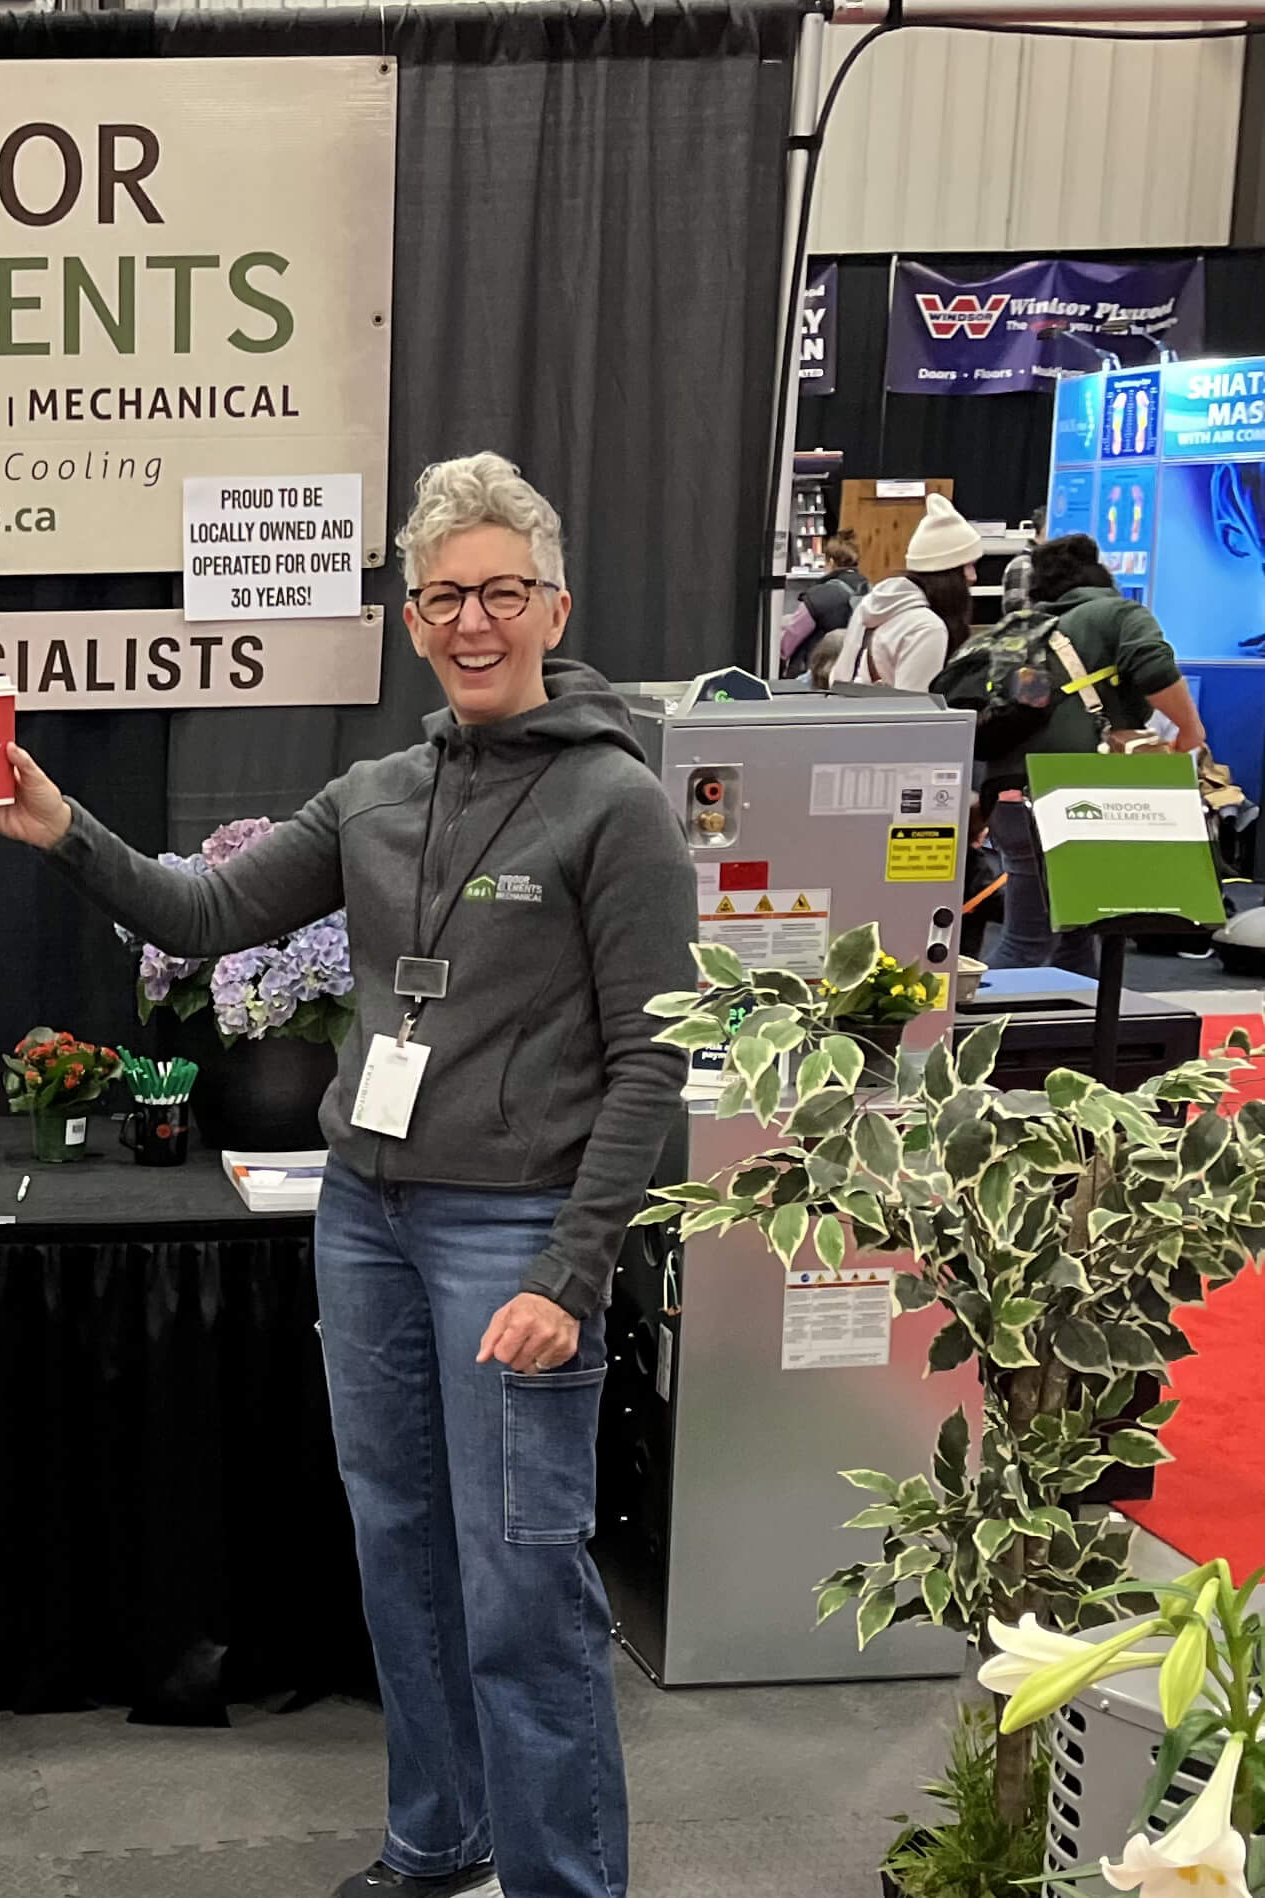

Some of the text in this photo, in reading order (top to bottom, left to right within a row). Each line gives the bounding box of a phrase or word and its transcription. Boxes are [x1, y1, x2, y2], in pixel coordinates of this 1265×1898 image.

[929, 312, 993, 322] WINDSOR
[1009, 298, 1091, 316] Windsor
[918, 368, 1013, 380] Doors Floors
[28, 385, 300, 422] MECHANICAL
[1178, 431, 1211, 446] WITH
[1212, 429, 1235, 443] AIR
[4, 451, 164, 487] Cooling
[221, 487, 323, 510] PROUD TO BE
[190, 519, 353, 543] LOCALLY OWNED AND
[192, 552, 352, 576] OPERATED FOR OVER
[231, 586, 312, 608] 30 YEARS!
[1102, 802, 1150, 812] INDOOR
[1104, 811, 1167, 821] ELEMENTS
